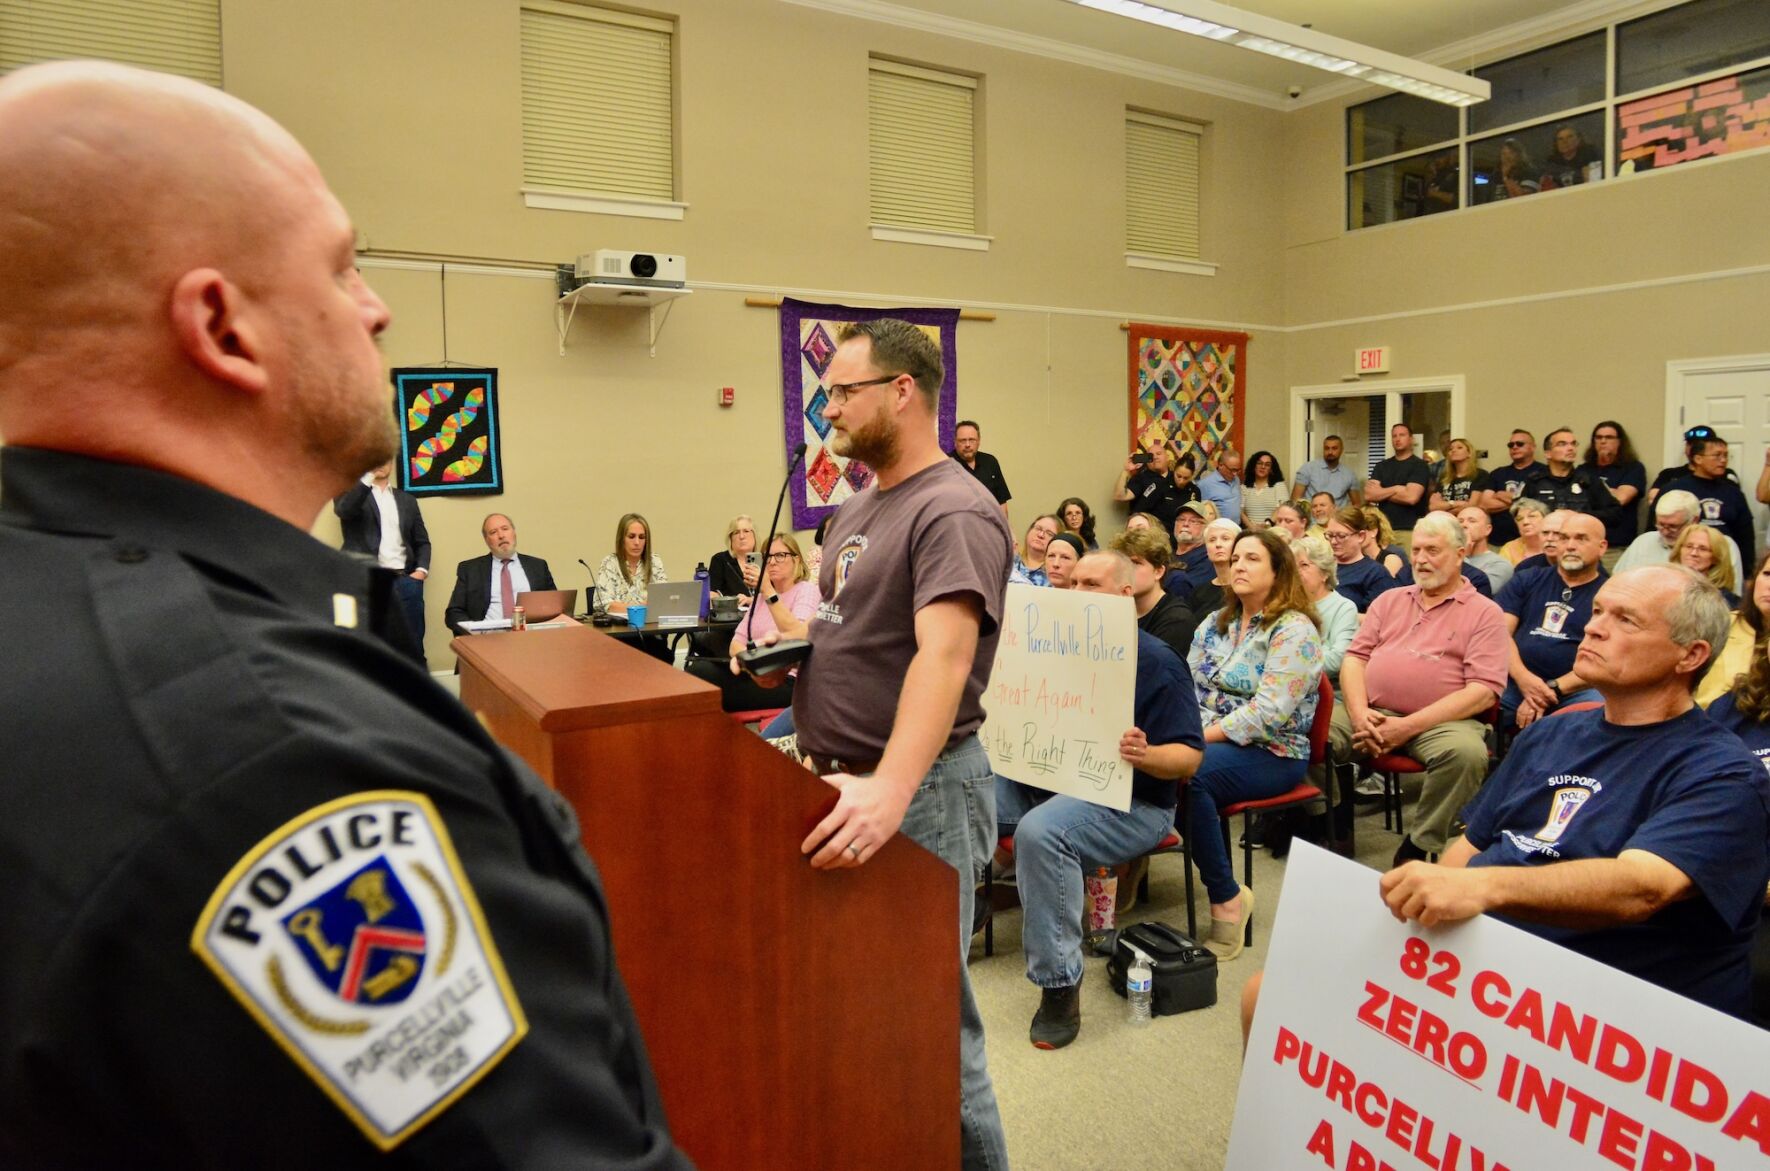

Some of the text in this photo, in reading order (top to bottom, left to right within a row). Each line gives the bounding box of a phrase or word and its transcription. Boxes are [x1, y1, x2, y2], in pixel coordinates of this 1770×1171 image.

[1361, 349, 1382, 369] EXIT
[1023, 602, 1080, 656] Purcellville
[1083, 603, 1125, 662] Police
[1022, 721, 1066, 776] Right
[219, 811, 415, 946] POLICE
[343, 966, 484, 1083] PURCELLVILLE
[389, 1008, 475, 1082] VIRGINIA
[1356, 980, 1488, 1081] ZERO
[1399, 936, 1770, 1157] 82 CANDIDA
[1306, 1119, 1335, 1169] A
